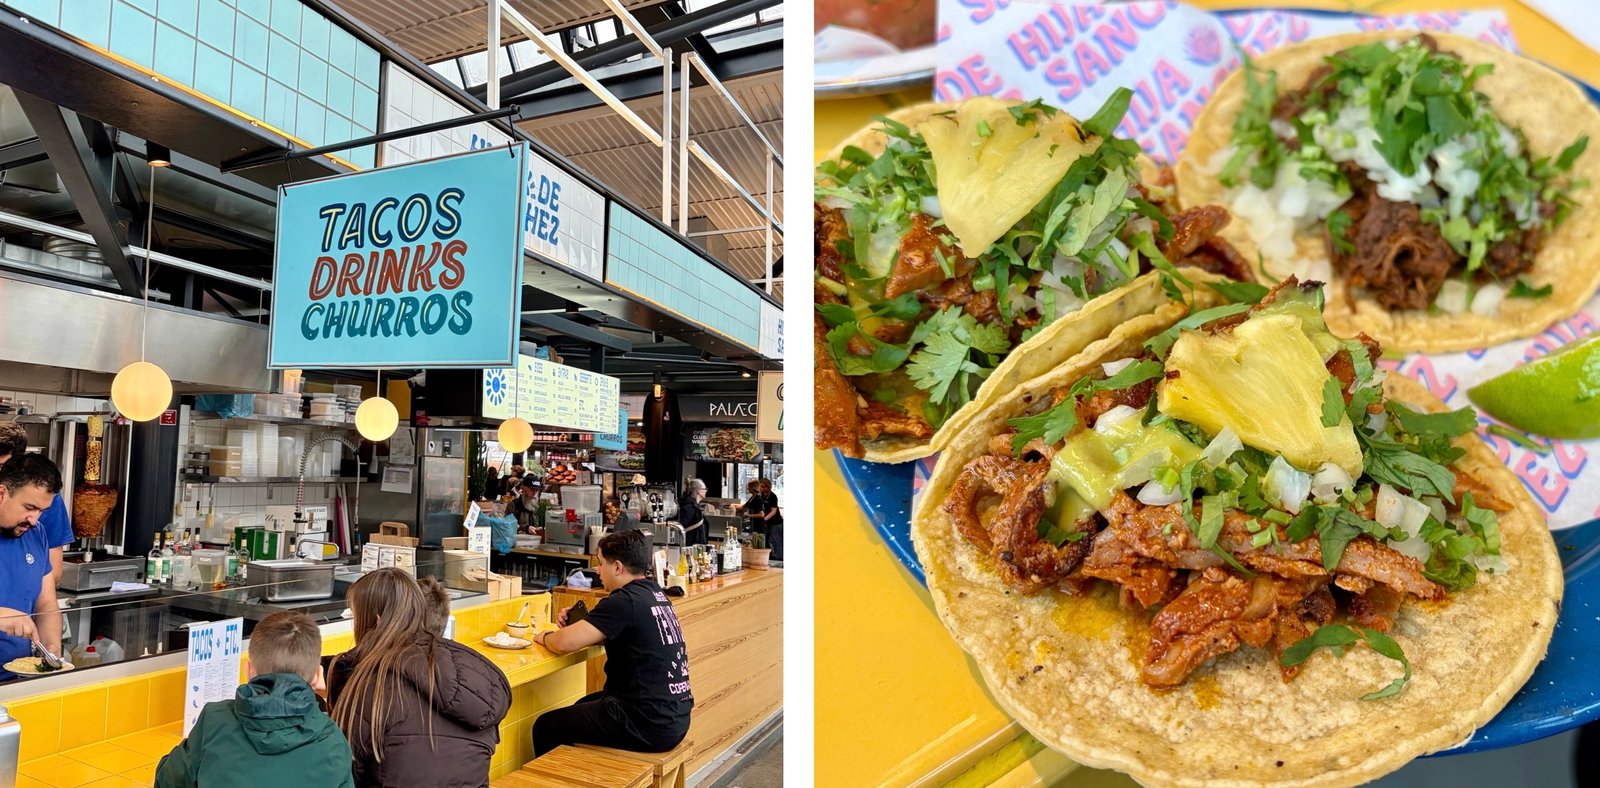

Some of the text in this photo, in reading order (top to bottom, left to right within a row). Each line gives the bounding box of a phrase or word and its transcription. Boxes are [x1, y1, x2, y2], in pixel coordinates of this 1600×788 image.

[319, 187, 465, 252] TACOS
[309, 239, 467, 301] DRINKS
[301, 290, 473, 340] CHURROS
[191, 627, 213, 663] TACOS
